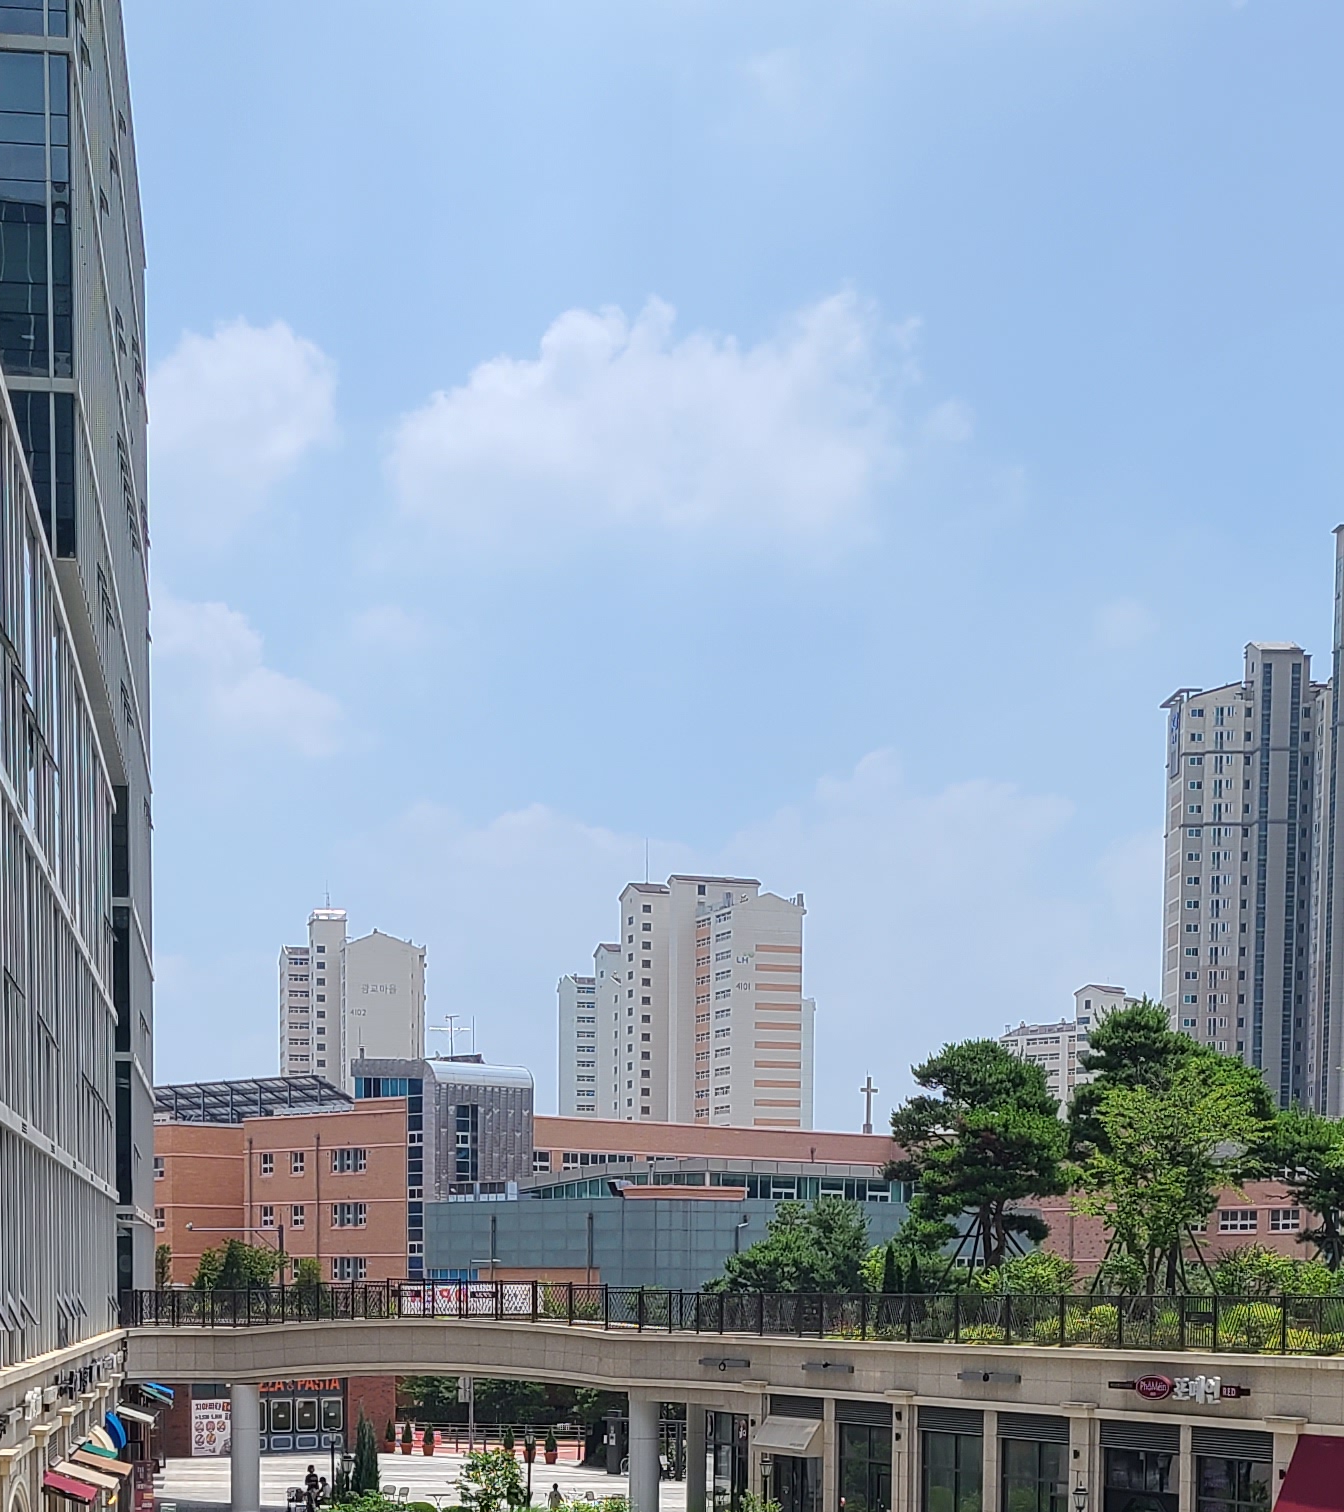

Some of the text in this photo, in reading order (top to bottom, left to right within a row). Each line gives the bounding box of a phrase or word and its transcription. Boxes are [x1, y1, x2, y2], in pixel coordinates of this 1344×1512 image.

[736, 956, 749, 964] LH
[736, 983, 751, 991] 4101
[1222, 1387, 1237, 1397] RED
